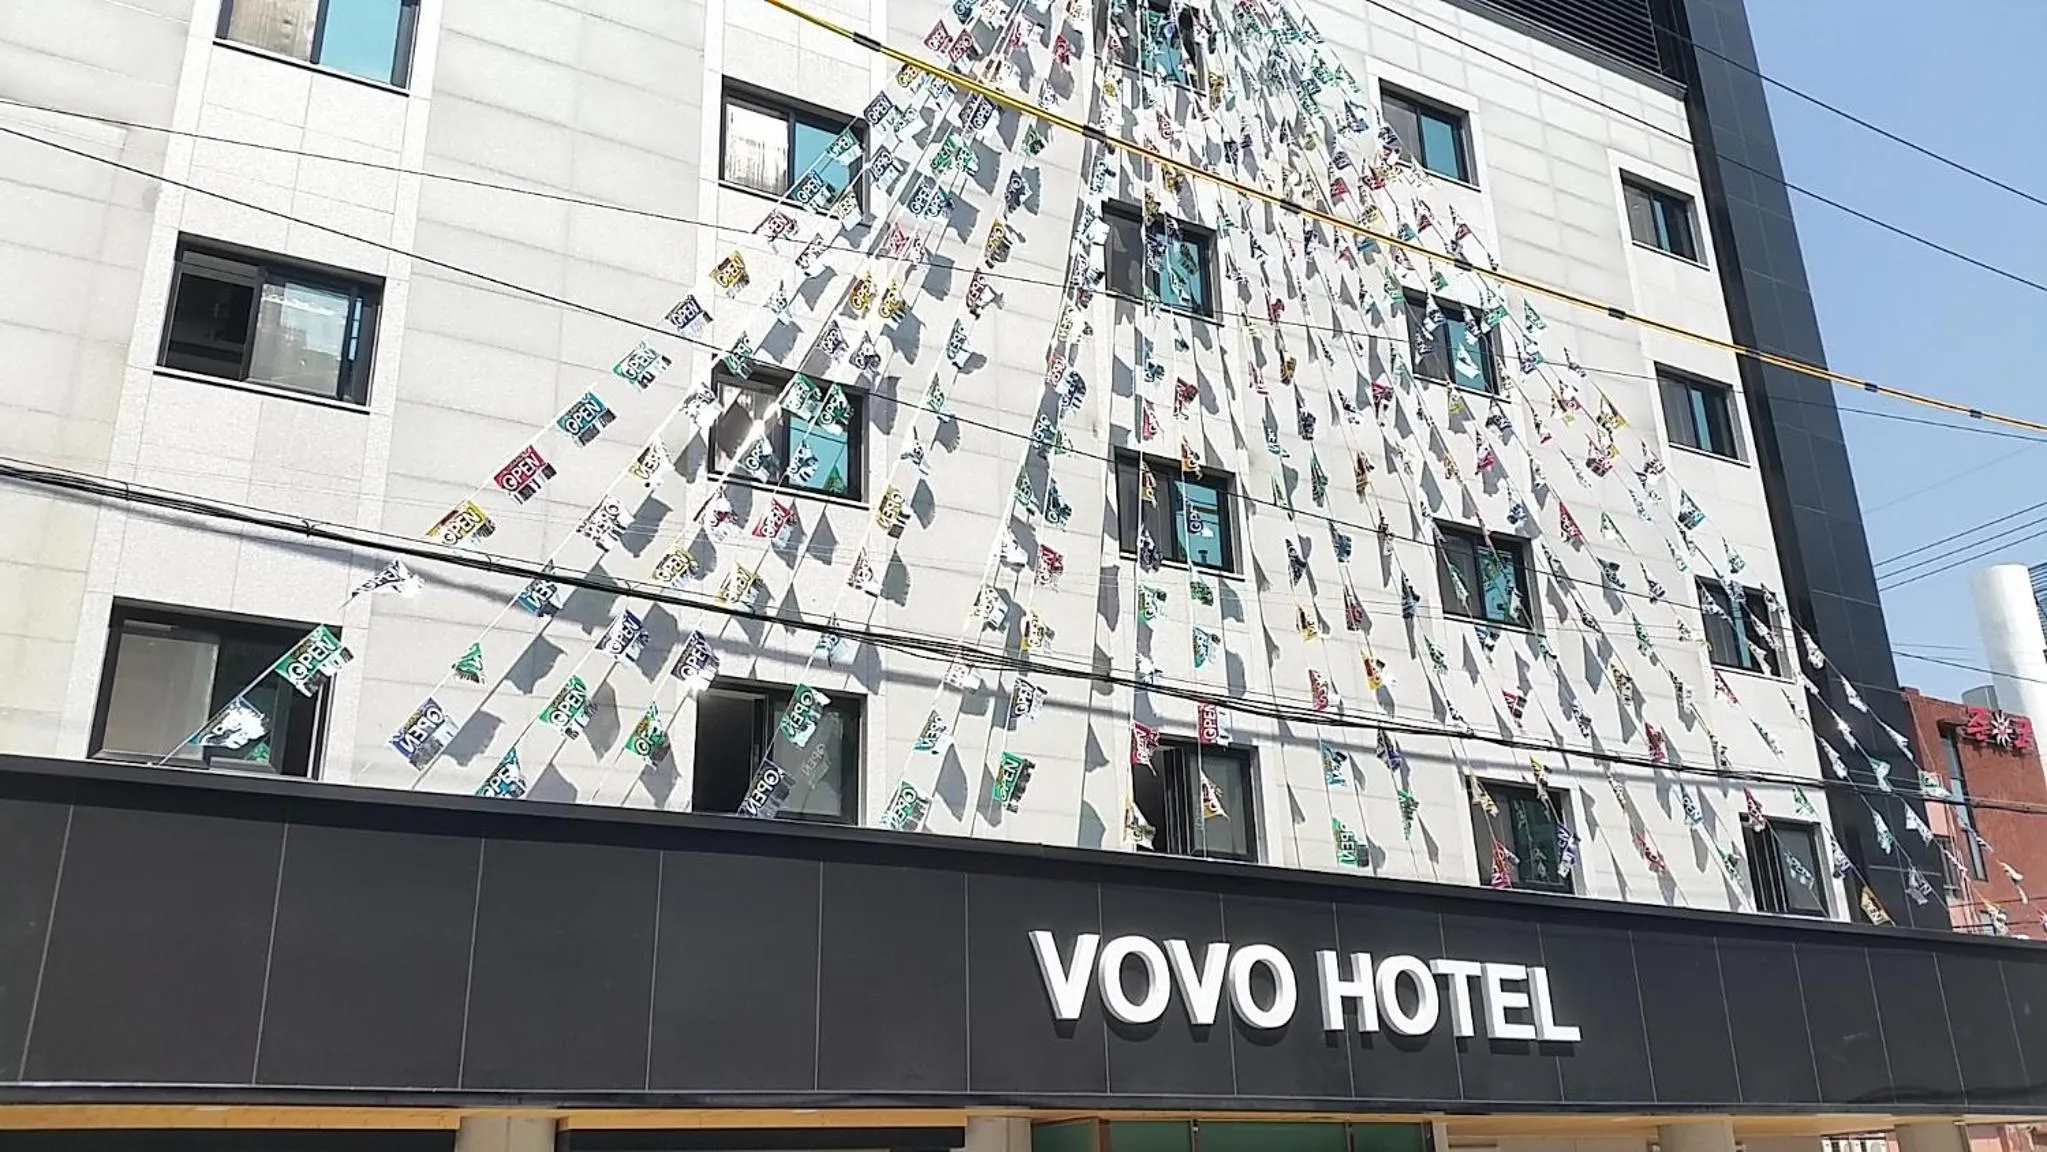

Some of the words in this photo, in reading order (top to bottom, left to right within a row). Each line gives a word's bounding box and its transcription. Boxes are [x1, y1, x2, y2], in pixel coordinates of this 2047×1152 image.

[868, 100, 890, 122] OPEN
[798, 173, 823, 202] OPEN
[718, 256, 745, 287] OPEN
[673, 301, 699, 328] OPEN
[625, 349, 657, 379] OPEN
[566, 402, 600, 434] OPEN
[503, 454, 539, 490] OPEN
[443, 508, 482, 545] OPEN
[762, 505, 788, 537] OPEN
[657, 550, 689, 581] OPEN
[607, 614, 640, 654] OPEN
[290, 637, 337, 680] OPEN
[680, 636, 706, 680] OPEN
[550, 684, 586, 723] OPEN
[483, 764, 511, 798] OPE
[1028, 930, 1297, 1029] VOVO
[1316, 949, 1580, 1041] HOTEL
